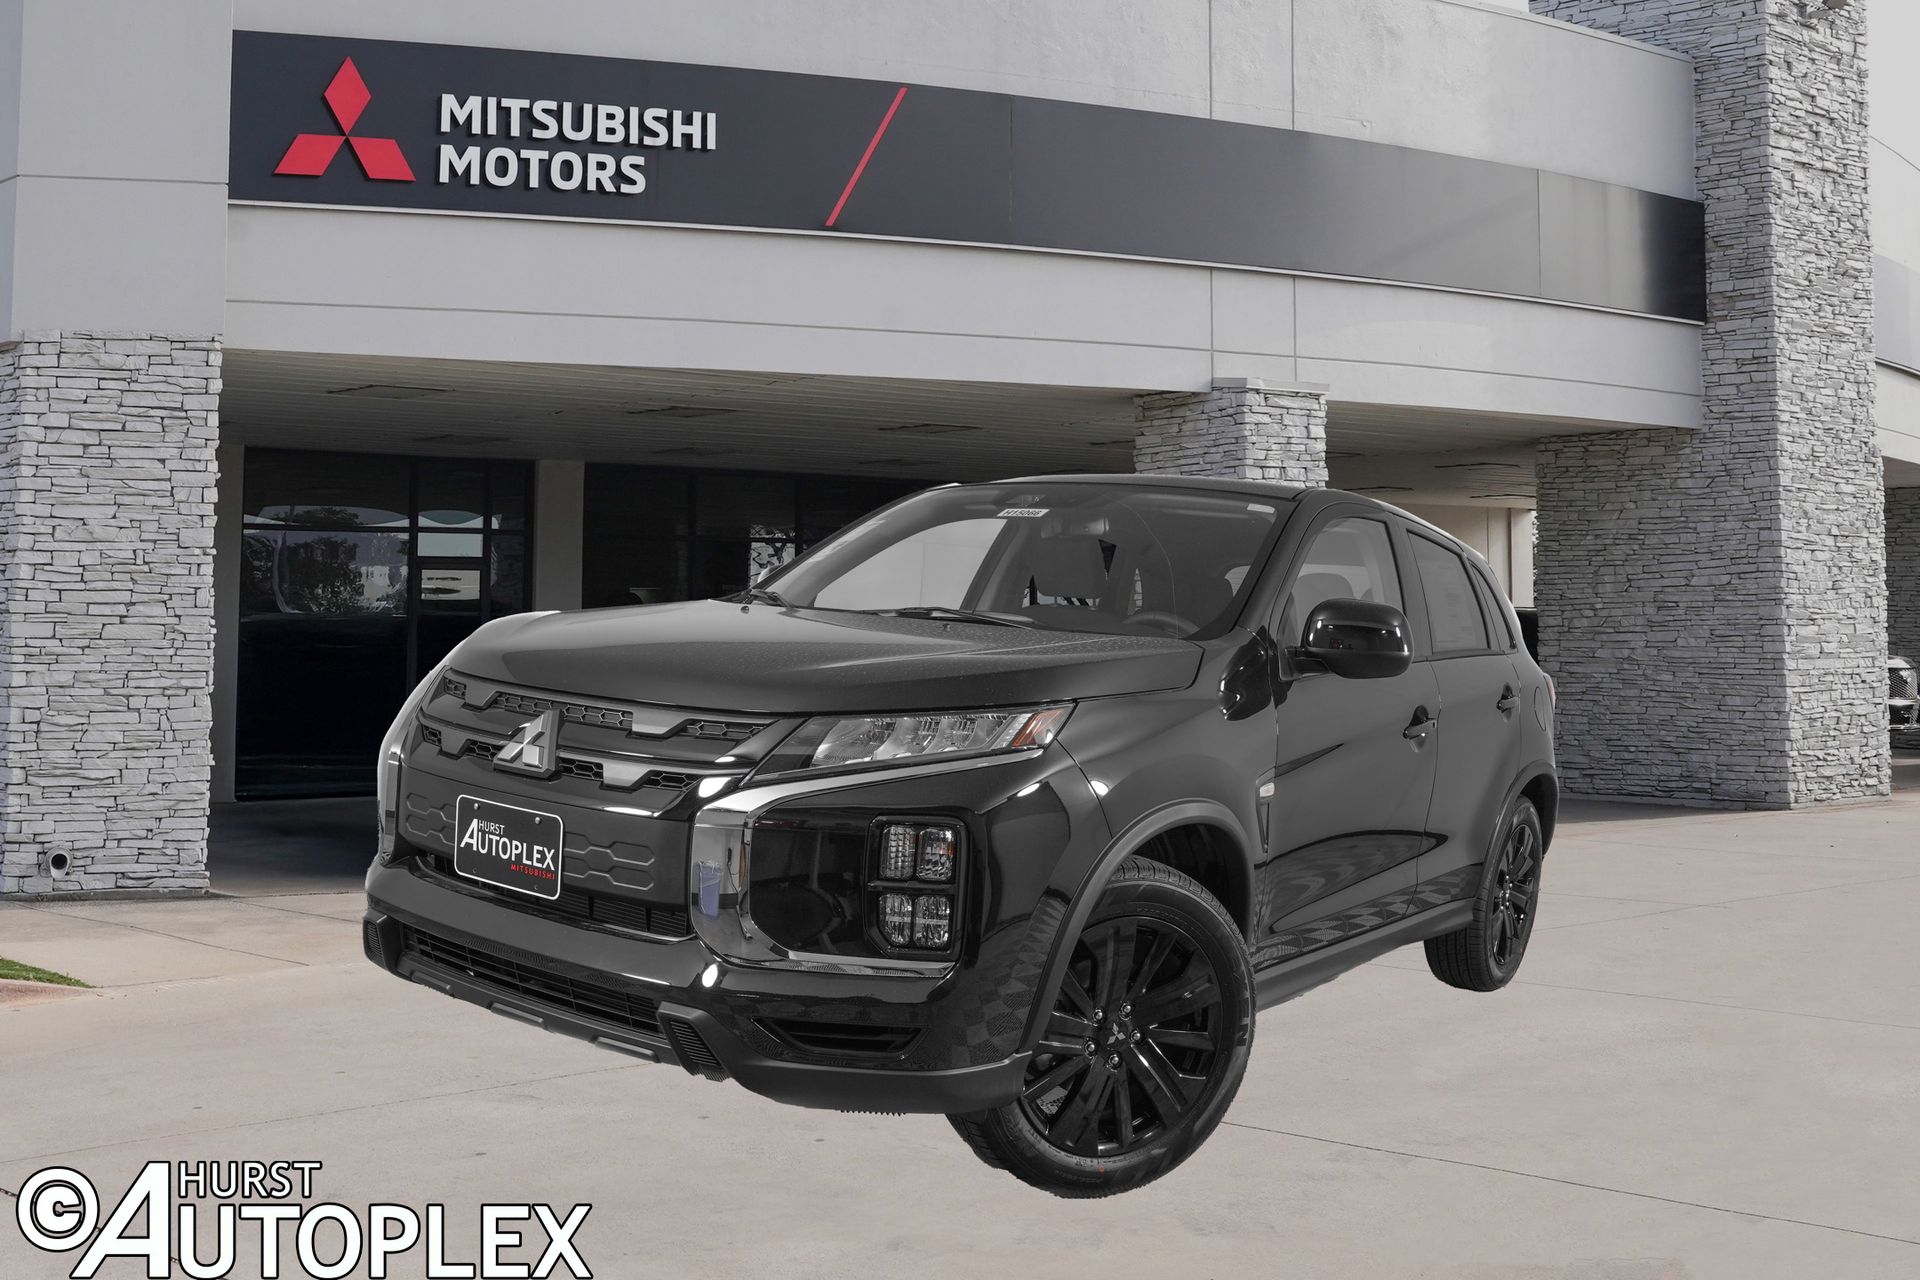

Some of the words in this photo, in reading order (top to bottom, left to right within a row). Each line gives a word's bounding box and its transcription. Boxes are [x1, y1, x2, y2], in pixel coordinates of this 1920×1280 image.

[439, 93, 717, 151] MITSUBISHI
[437, 144, 647, 195] MOTORS
[460, 818, 555, 871] AUTOPLEX
[478, 819, 505, 836] HURST
[510, 863, 556, 881] MITSUBISHI
